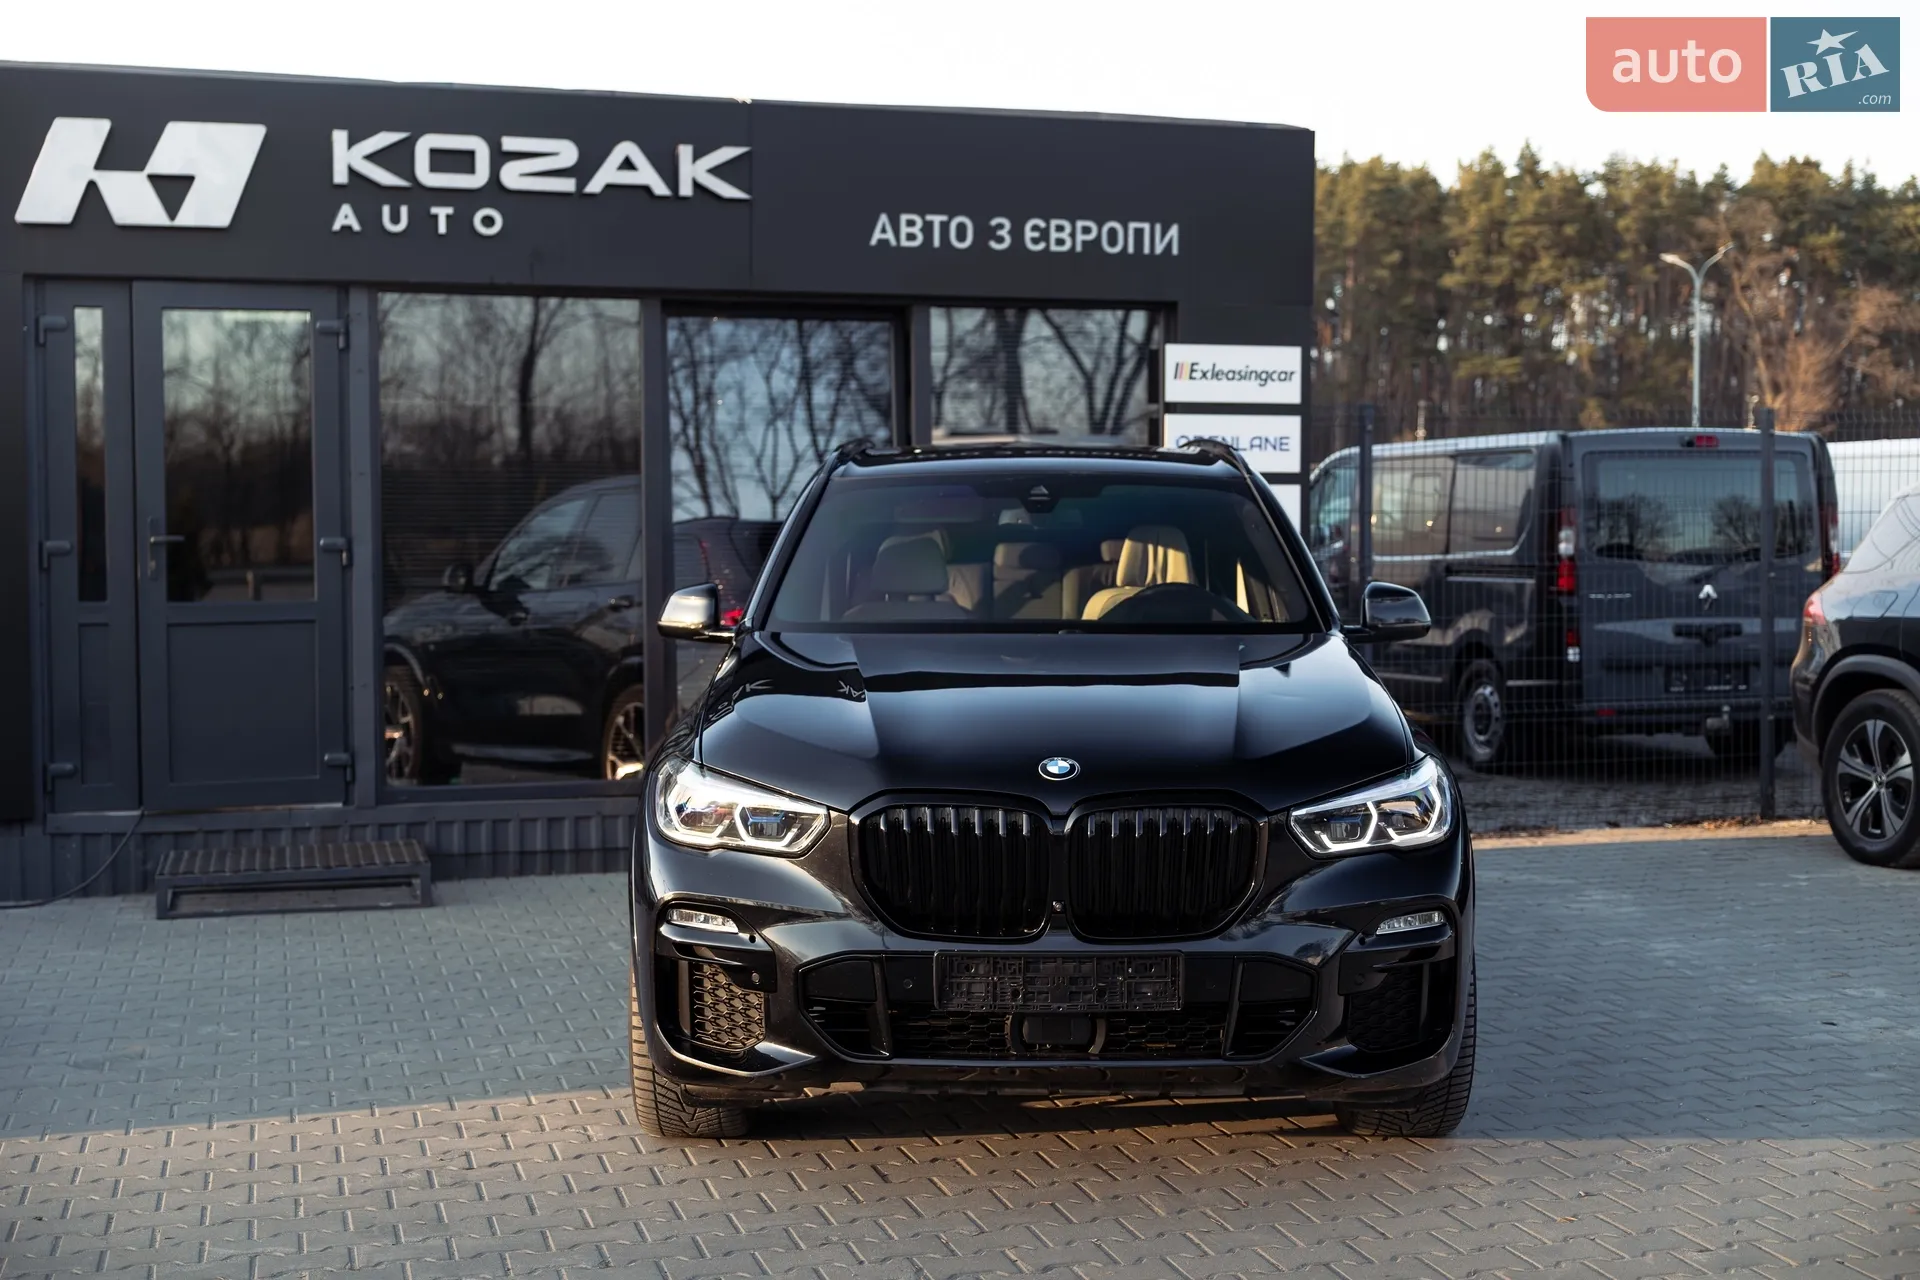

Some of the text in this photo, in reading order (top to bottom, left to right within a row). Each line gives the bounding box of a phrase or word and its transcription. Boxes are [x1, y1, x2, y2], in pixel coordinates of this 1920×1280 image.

[331, 128, 752, 200] KOZAK
[331, 203, 504, 236] AUTO
[869, 213, 974, 250] АВТО
[1024, 218, 1180, 256] ЄВРОПИ
[1188, 362, 1296, 388] Exleasingcar
